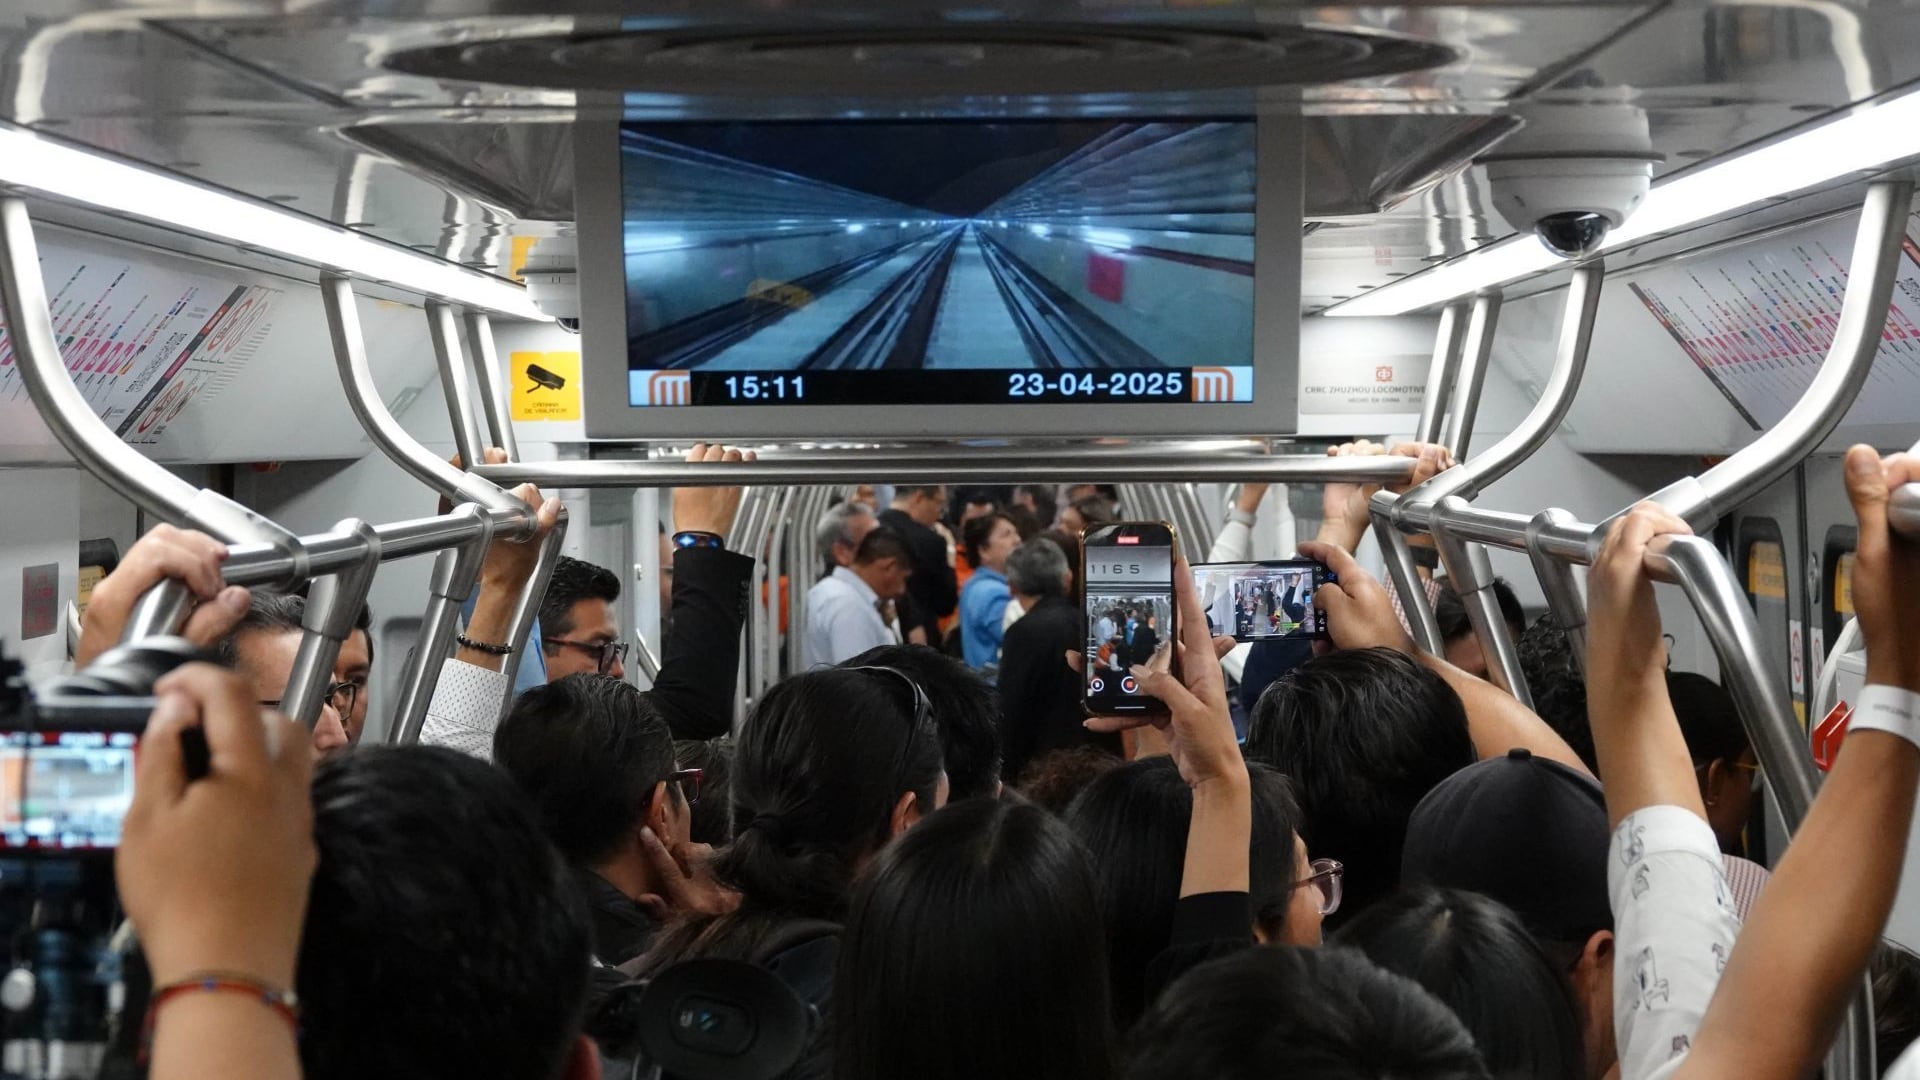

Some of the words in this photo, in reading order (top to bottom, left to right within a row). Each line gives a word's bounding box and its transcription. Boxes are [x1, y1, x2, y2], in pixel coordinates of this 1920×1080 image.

[725, 376, 804, 398] 15:11
[1008, 373, 1183, 396] 23-04-2025
[1091, 564, 1141, 574] 1165
